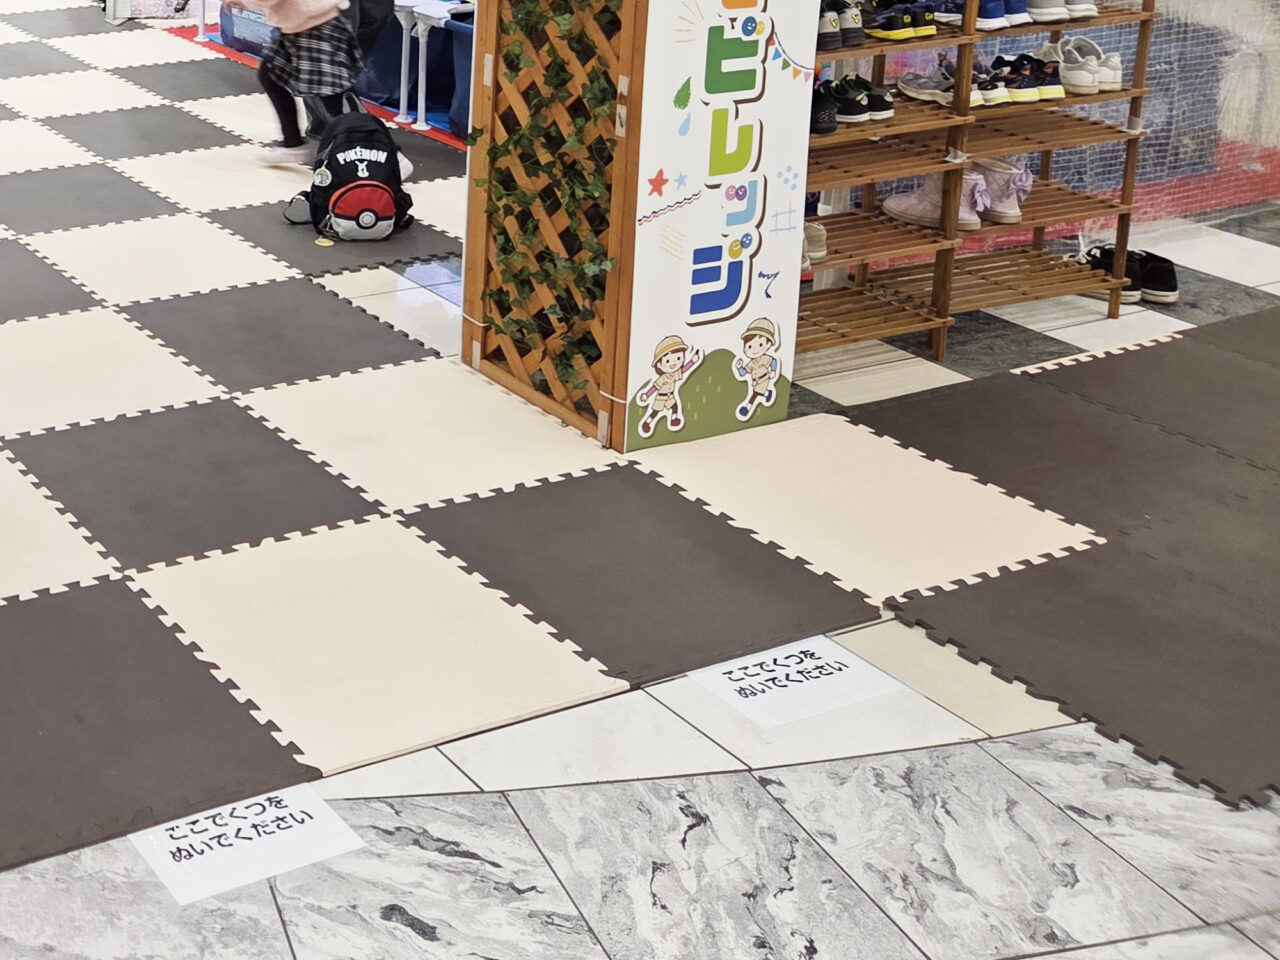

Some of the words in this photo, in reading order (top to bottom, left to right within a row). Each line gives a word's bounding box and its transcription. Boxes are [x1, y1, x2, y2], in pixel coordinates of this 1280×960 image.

[720, 648, 824, 684] ここでくつを
[733, 660, 850, 701] ぬいでください
[164, 792, 289, 843] ここでくつを
[169, 809, 315, 866] ぬいでください
